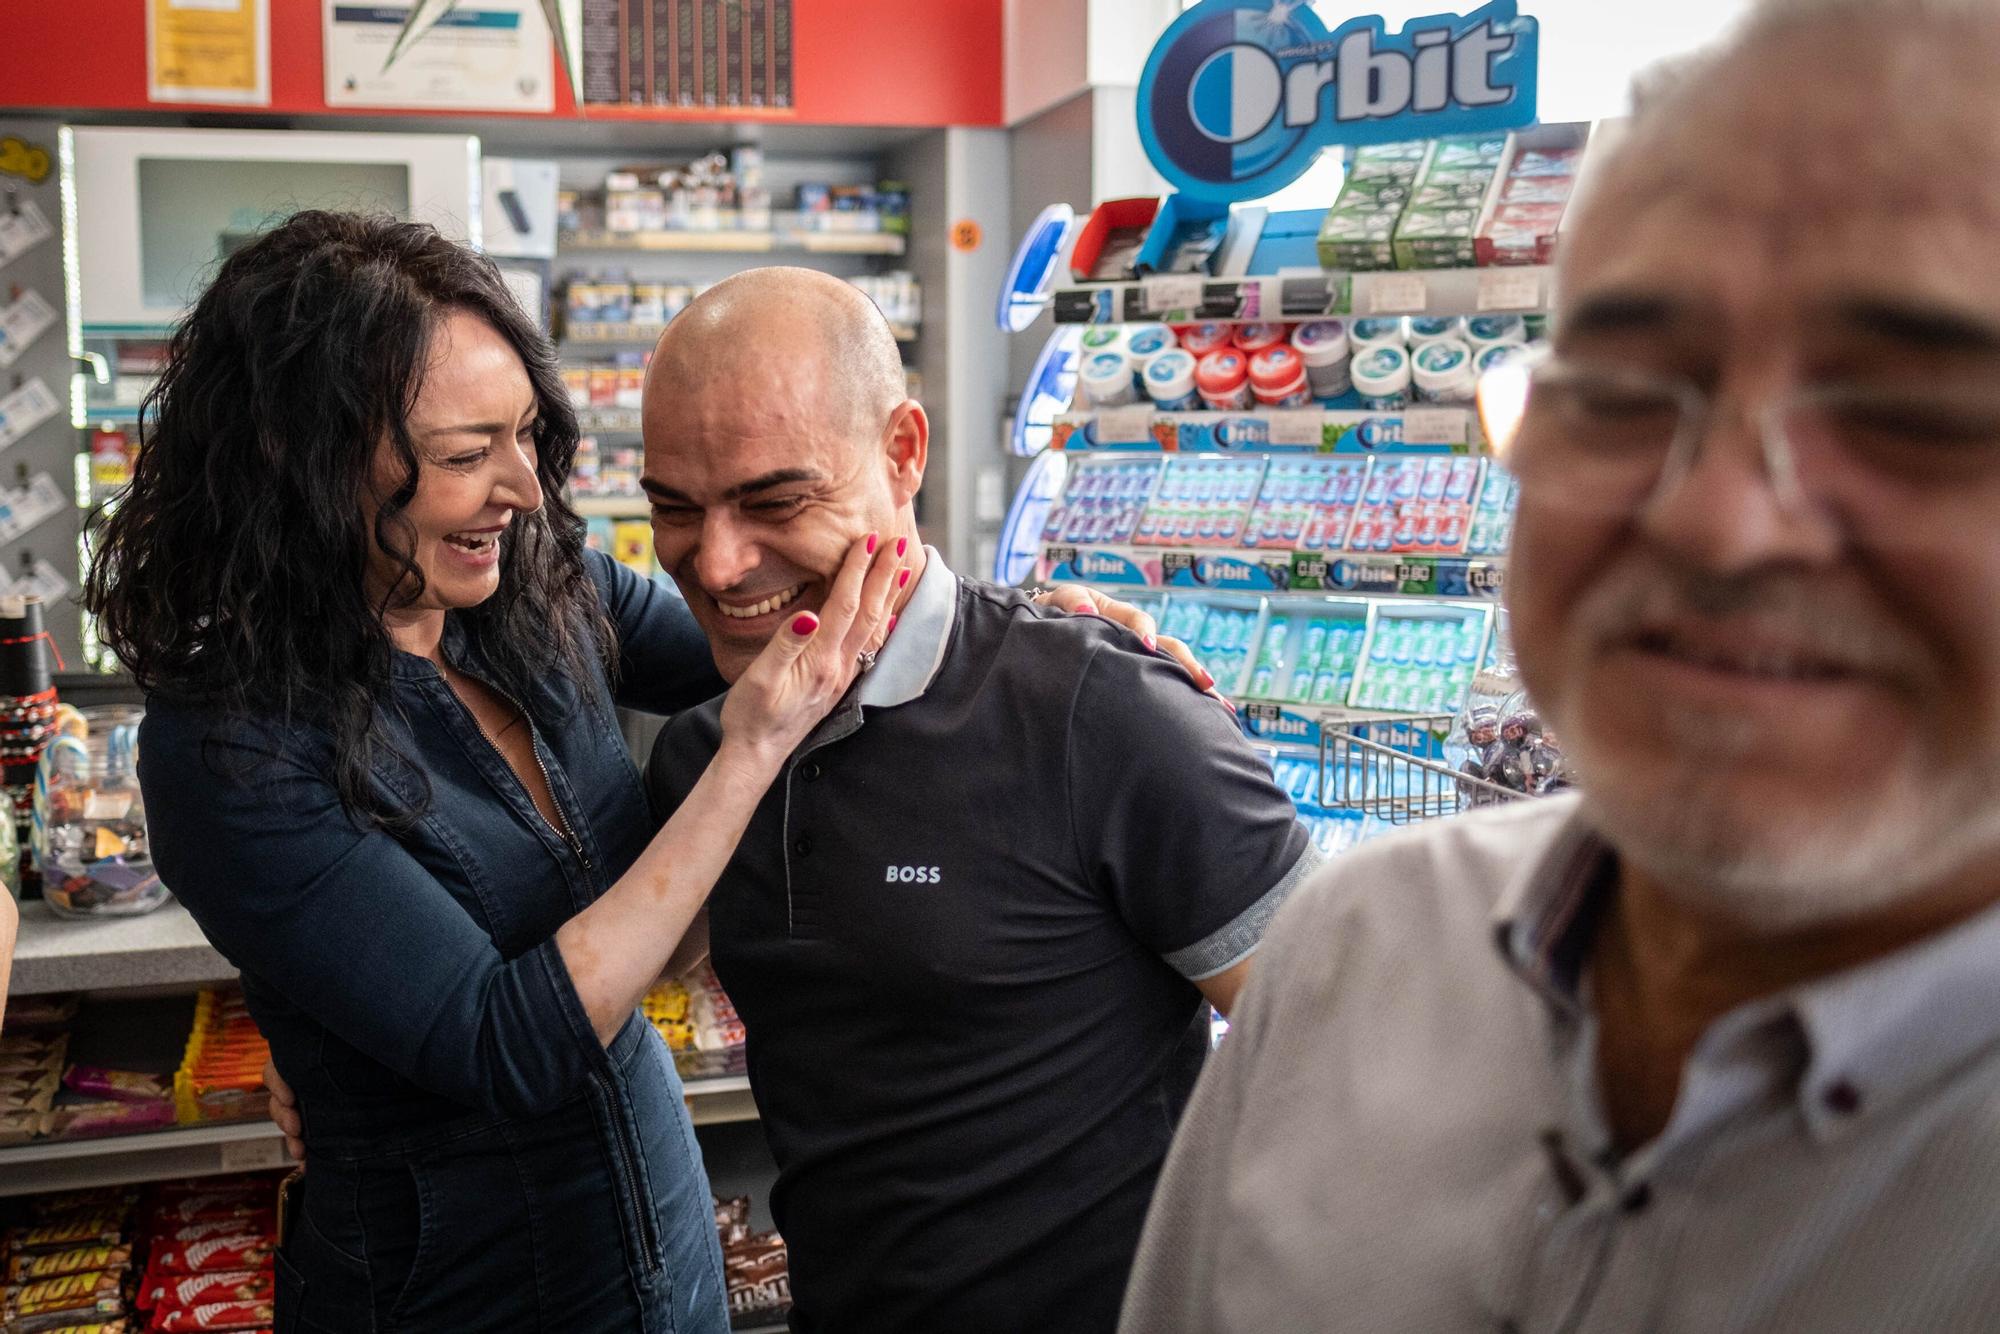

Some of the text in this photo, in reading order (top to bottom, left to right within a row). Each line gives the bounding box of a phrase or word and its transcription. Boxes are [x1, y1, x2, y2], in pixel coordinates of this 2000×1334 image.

[1151, 8, 1515, 184] Orbit
[1070, 552, 1126, 578] Orbit
[1190, 556, 1251, 584] Orbit
[886, 865, 941, 883] BOSS
[17, 1271, 103, 1306] LION
